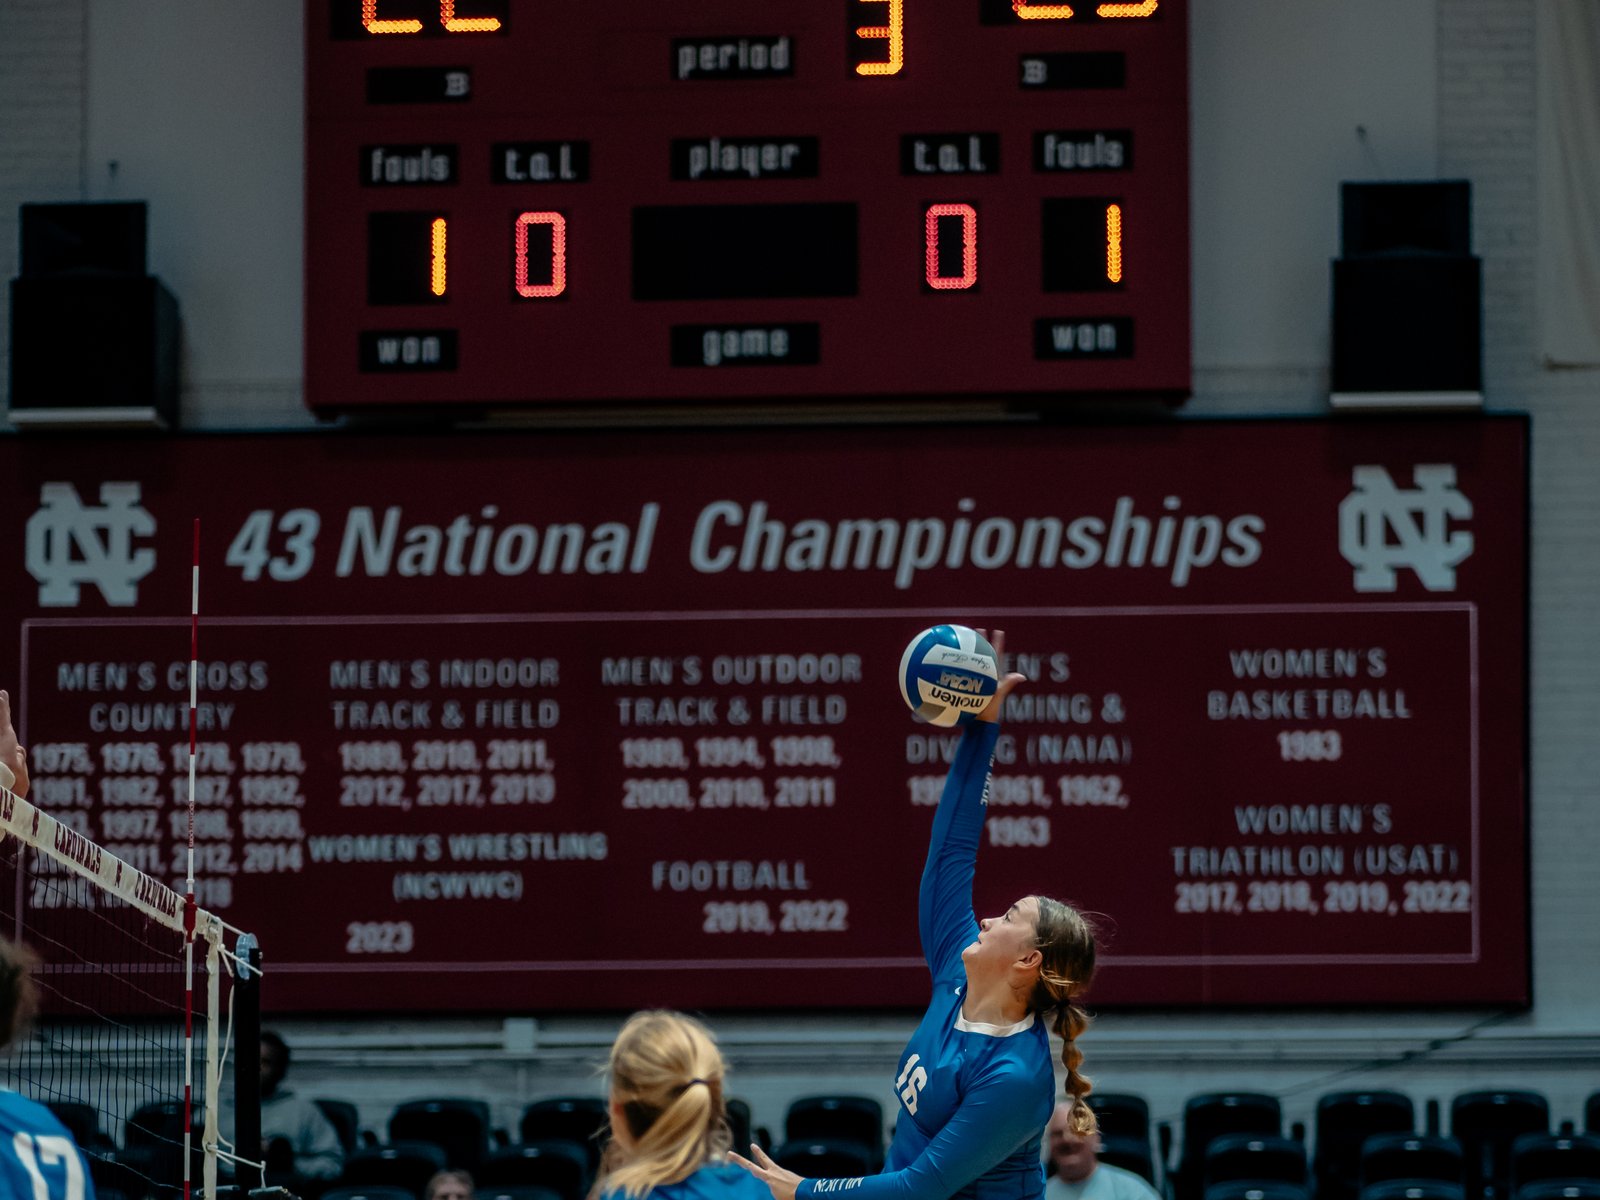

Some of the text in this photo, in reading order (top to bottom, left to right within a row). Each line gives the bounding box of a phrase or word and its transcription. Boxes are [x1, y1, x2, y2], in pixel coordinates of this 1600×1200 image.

[856, 0, 904, 75] 3
[678, 37, 790, 80] period
[371, 148, 450, 183] fouls
[690, 137, 799, 179] player
[1044, 135, 1124, 168] fouls
[431, 218, 446, 296] 1
[515, 211, 566, 298] 0
[926, 203, 977, 290] 0
[1107, 204, 1122, 283] 1
[377, 335, 441, 364] won
[702, 328, 789, 367] game
[1052, 323, 1117, 352] won
[226, 495, 1266, 590] 43 National Championships
[57, 660, 157, 692] MEN'S
[329, 657, 560, 690] MEN'S INDOOR
[601, 653, 863, 687] MEN'S OUTDOOR
[1229, 647, 1388, 679] WOMEN'S
[931, 686, 984, 708] molten
[939, 671, 984, 694] NCAA
[331, 699, 560, 730] TRACK & FIELD
[618, 694, 848, 727] TRACK & FIELD
[1100, 692, 1126, 724] &
[1207, 688, 1413, 720] BASKETBALL
[906, 733, 1018, 765] DIVG
[1026, 733, 1133, 767] (NAIA)
[1234, 803, 1394, 835] WOMEN'S
[308, 832, 608, 863] WOMEN'S WRESTLING
[1171, 843, 1460, 878] TRIATHLON (USAT)
[651, 859, 812, 892] FOOTBALL
[896, 1053, 928, 1116] 16
